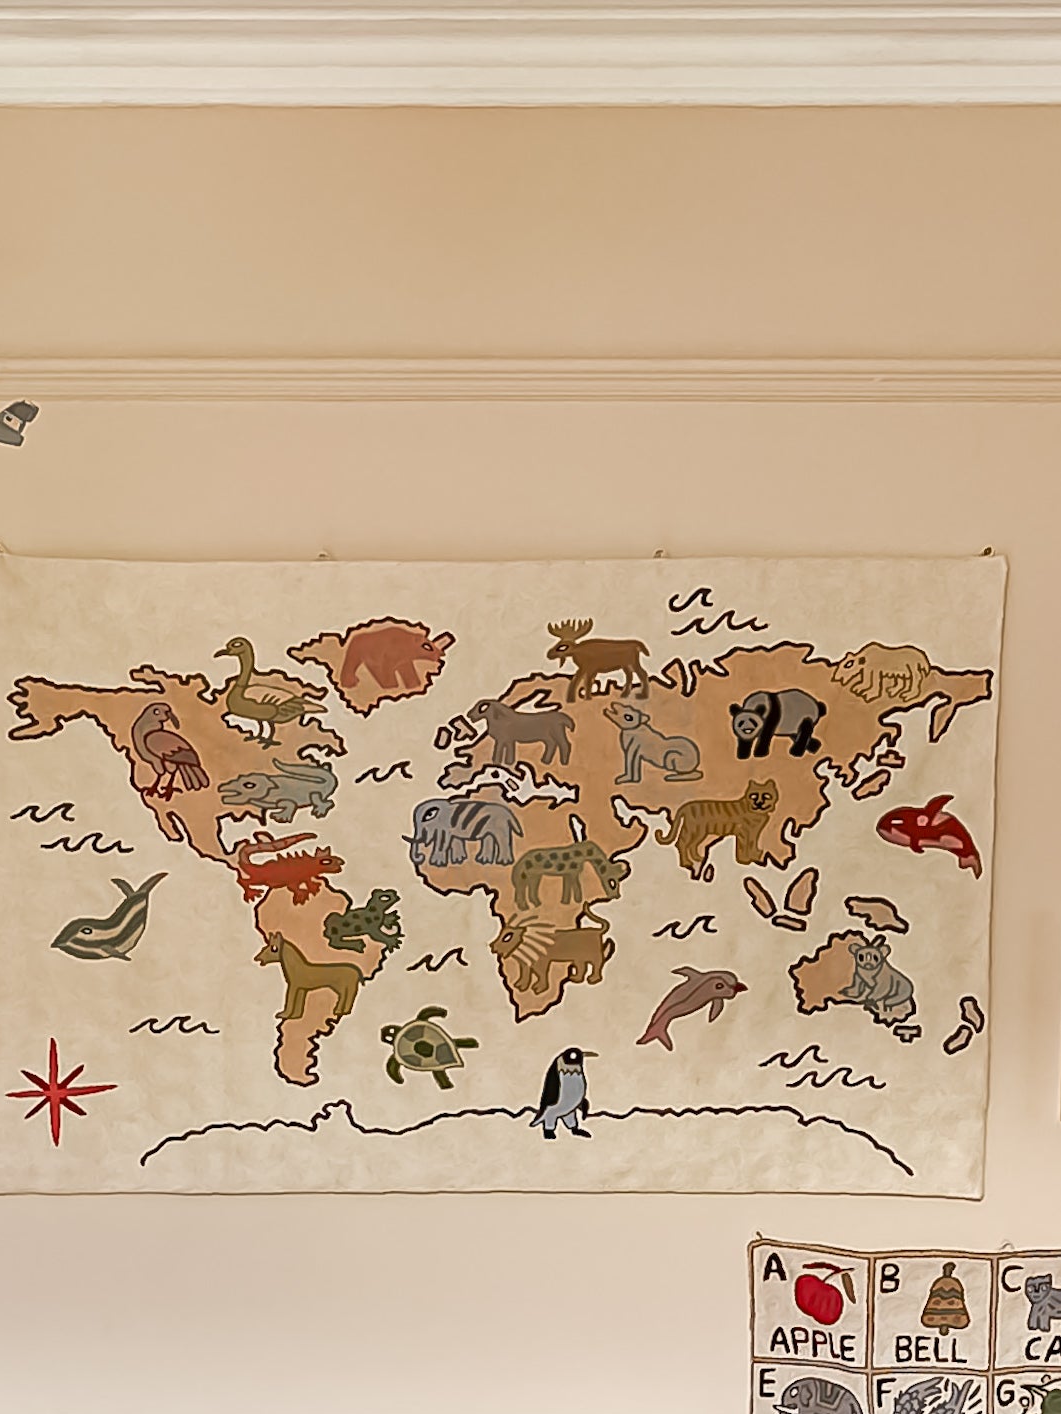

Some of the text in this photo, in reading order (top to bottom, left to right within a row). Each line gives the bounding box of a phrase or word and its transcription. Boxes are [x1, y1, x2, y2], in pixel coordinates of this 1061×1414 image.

[763, 1252, 787, 1281] A
[879, 1263, 900, 1294] B
[1001, 1265, 1024, 1292] C
[770, 1327, 856, 1362] APPLE
[895, 1335, 968, 1363] BELL
[759, 1368, 777, 1398] E
[876, 1378, 897, 1408] F
[996, 1379, 1015, 1407] G
